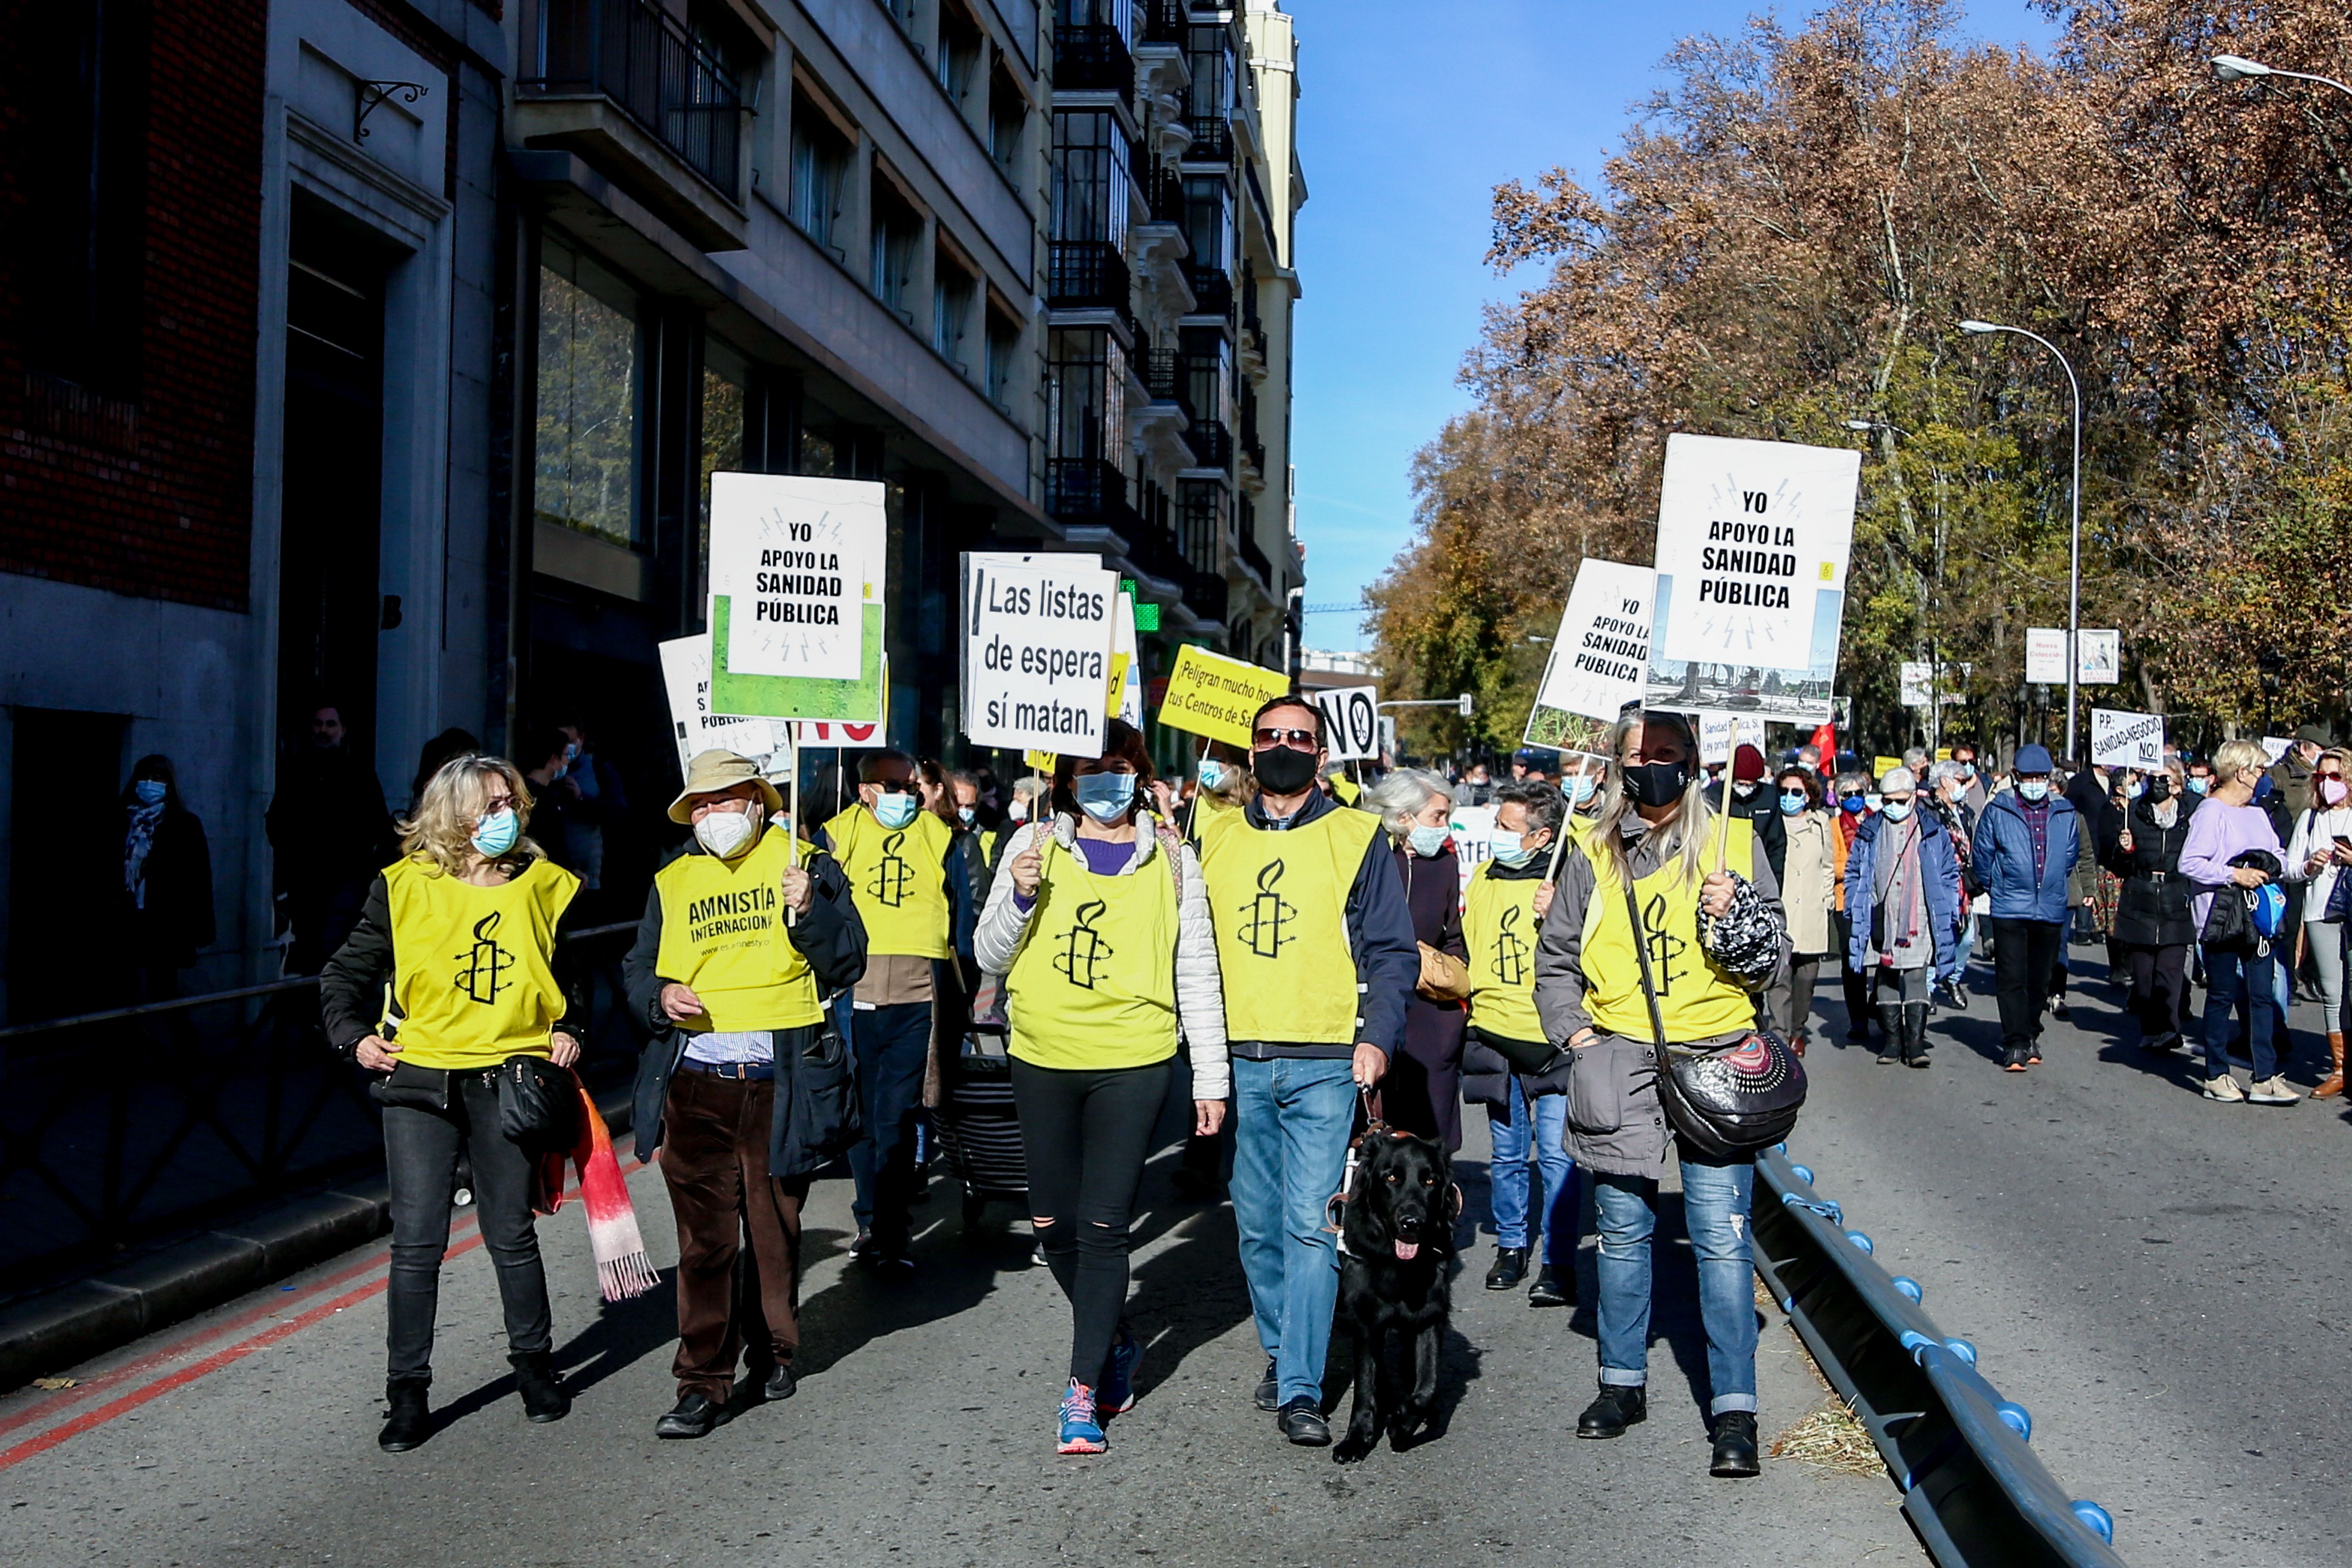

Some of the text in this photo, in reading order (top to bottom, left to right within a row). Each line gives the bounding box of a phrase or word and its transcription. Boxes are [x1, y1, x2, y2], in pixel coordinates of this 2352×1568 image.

[1743, 491, 1767, 513] YO
[789, 523, 811, 542] YO
[1708, 521, 1794, 547] APOYO LA
[761, 549, 838, 570] APOYO LA
[1702, 547, 1796, 576] SANIDAD
[757, 573, 842, 597] SANIDAD
[1700, 577, 1789, 609] PÚBLICA
[757, 598, 838, 625] PÚBLICA
[989, 578, 1103, 621] Las listas
[1621, 598, 1640, 615] YO
[1592, 616, 1635, 636] APOYO
[985, 634, 1012, 671] de
[1021, 646, 1102, 685] espera
[1582, 632, 1647, 661] SANIDAD
[1574, 653, 1639, 683] PÚBLICA
[1221, 679, 1255, 698] mucho
[987, 692, 1008, 728] sí
[1016, 699, 1094, 736] matan.
[1168, 689, 1183, 707] tus
[1185, 693, 1224, 720] Centros
[1225, 706, 1238, 724] de
[1705, 722, 1727, 734] Sanidad
[2094, 717, 2161, 756] SANIDAD-NEGOCIO
[1703, 740, 1713, 754] Ley
[2140, 742, 2158, 758] NO!
[689, 882, 775, 925] AMNISTÍA
